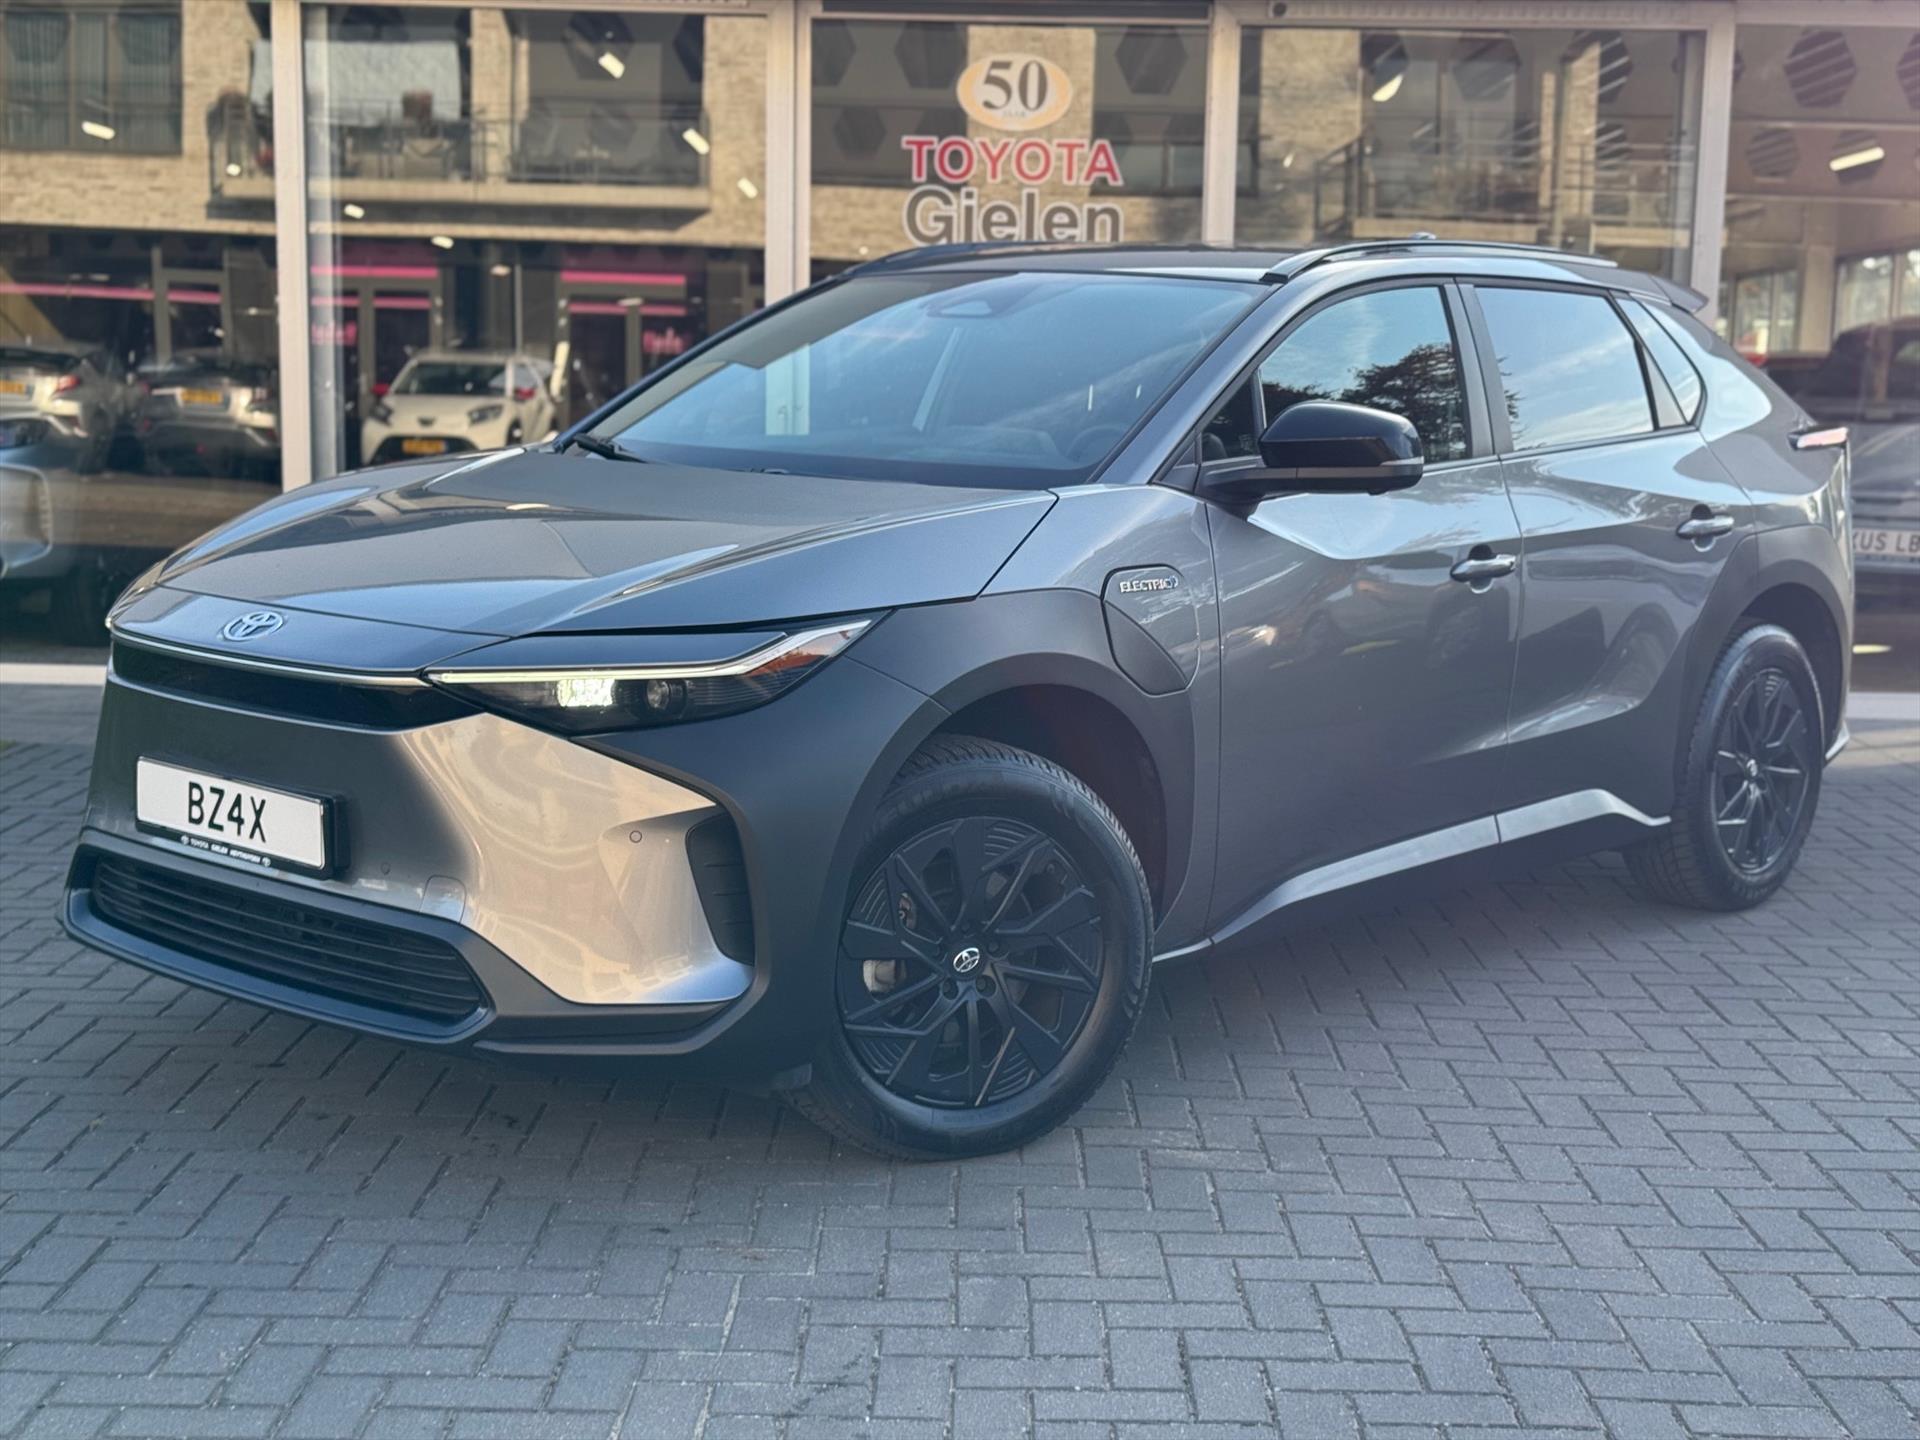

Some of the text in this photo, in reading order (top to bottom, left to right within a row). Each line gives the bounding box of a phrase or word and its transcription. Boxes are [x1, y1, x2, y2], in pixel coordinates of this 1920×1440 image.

[982, 61, 1048, 110] 50
[904, 138, 1122, 185] TOYOTA
[905, 187, 1121, 243] Gielen
[1120, 578, 1172, 593] ELECTRIC
[188, 781, 266, 843] BZ4X
